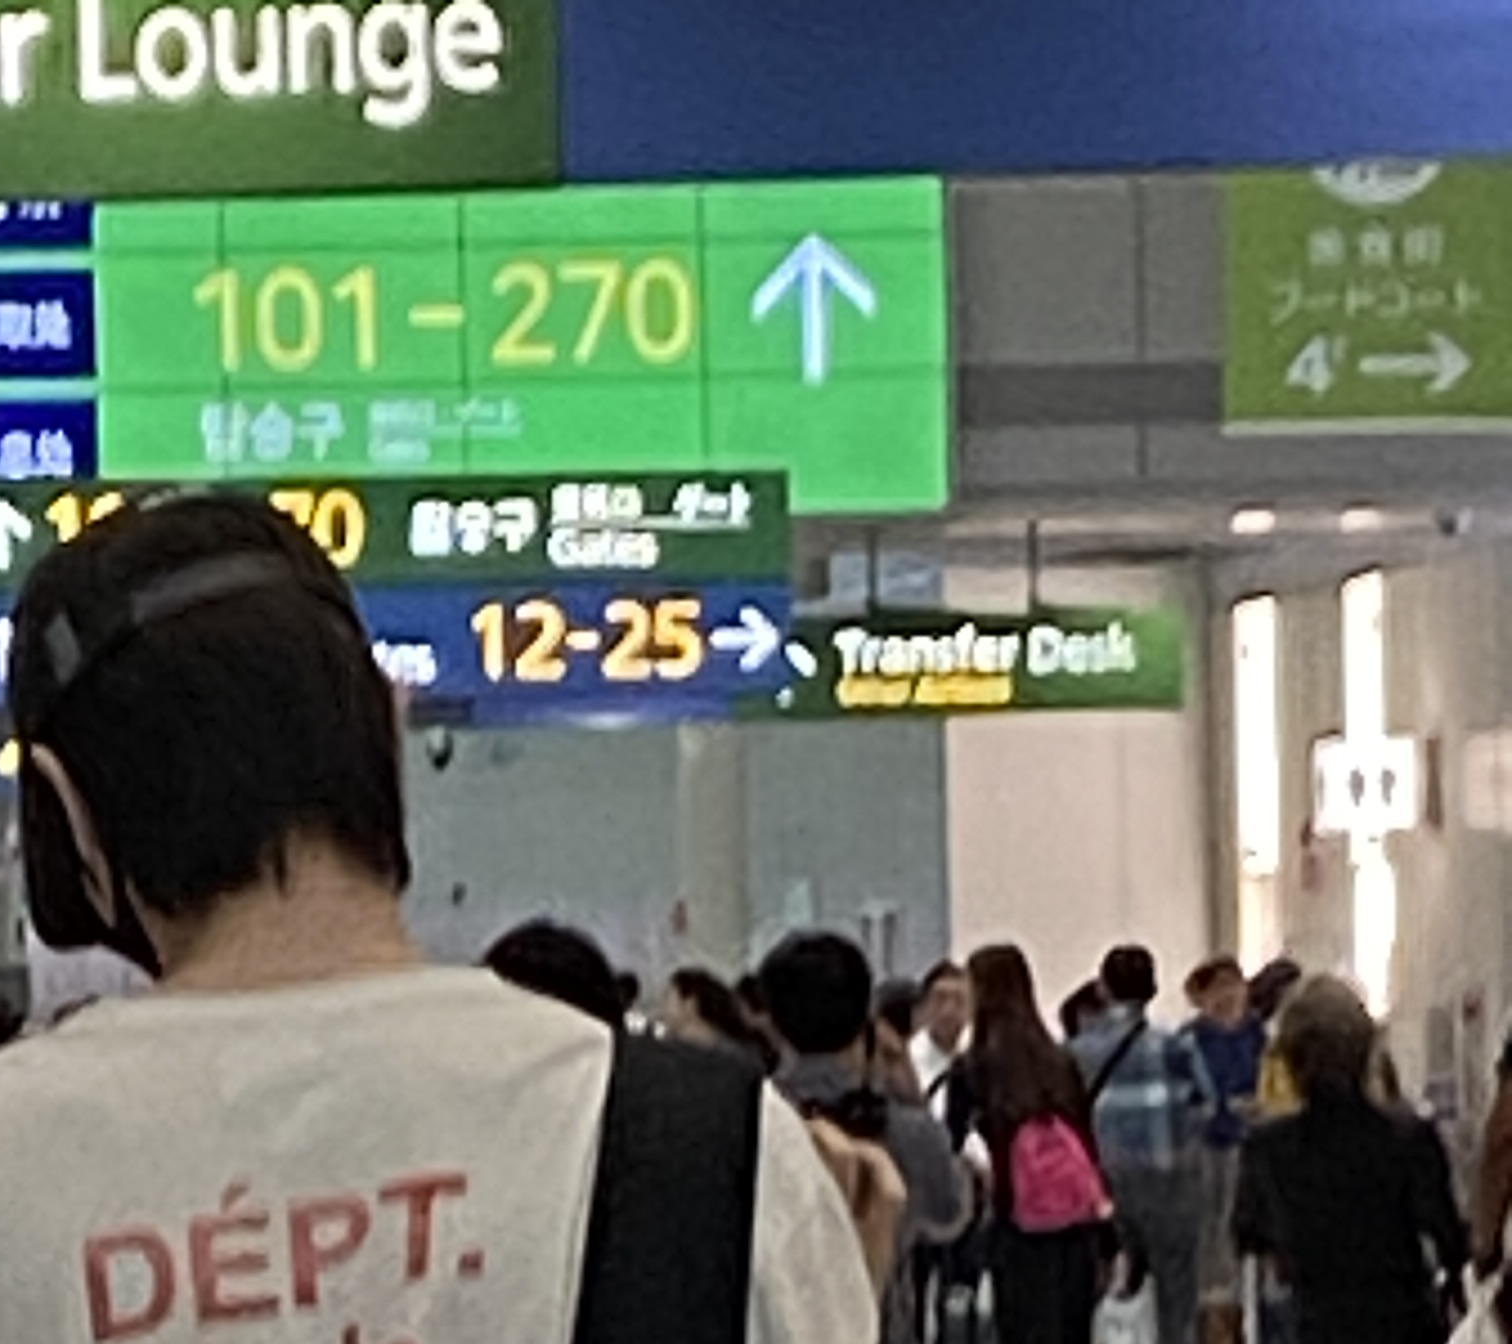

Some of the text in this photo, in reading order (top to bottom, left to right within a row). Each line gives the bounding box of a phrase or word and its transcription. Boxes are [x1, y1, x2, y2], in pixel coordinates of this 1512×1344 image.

[79, 0, 503, 128] Lounge
[470, 598, 705, 683] 12-25
[832, 620, 1136, 676] Transfer Desk
[83, 1174, 485, 1344] DÉPT.
